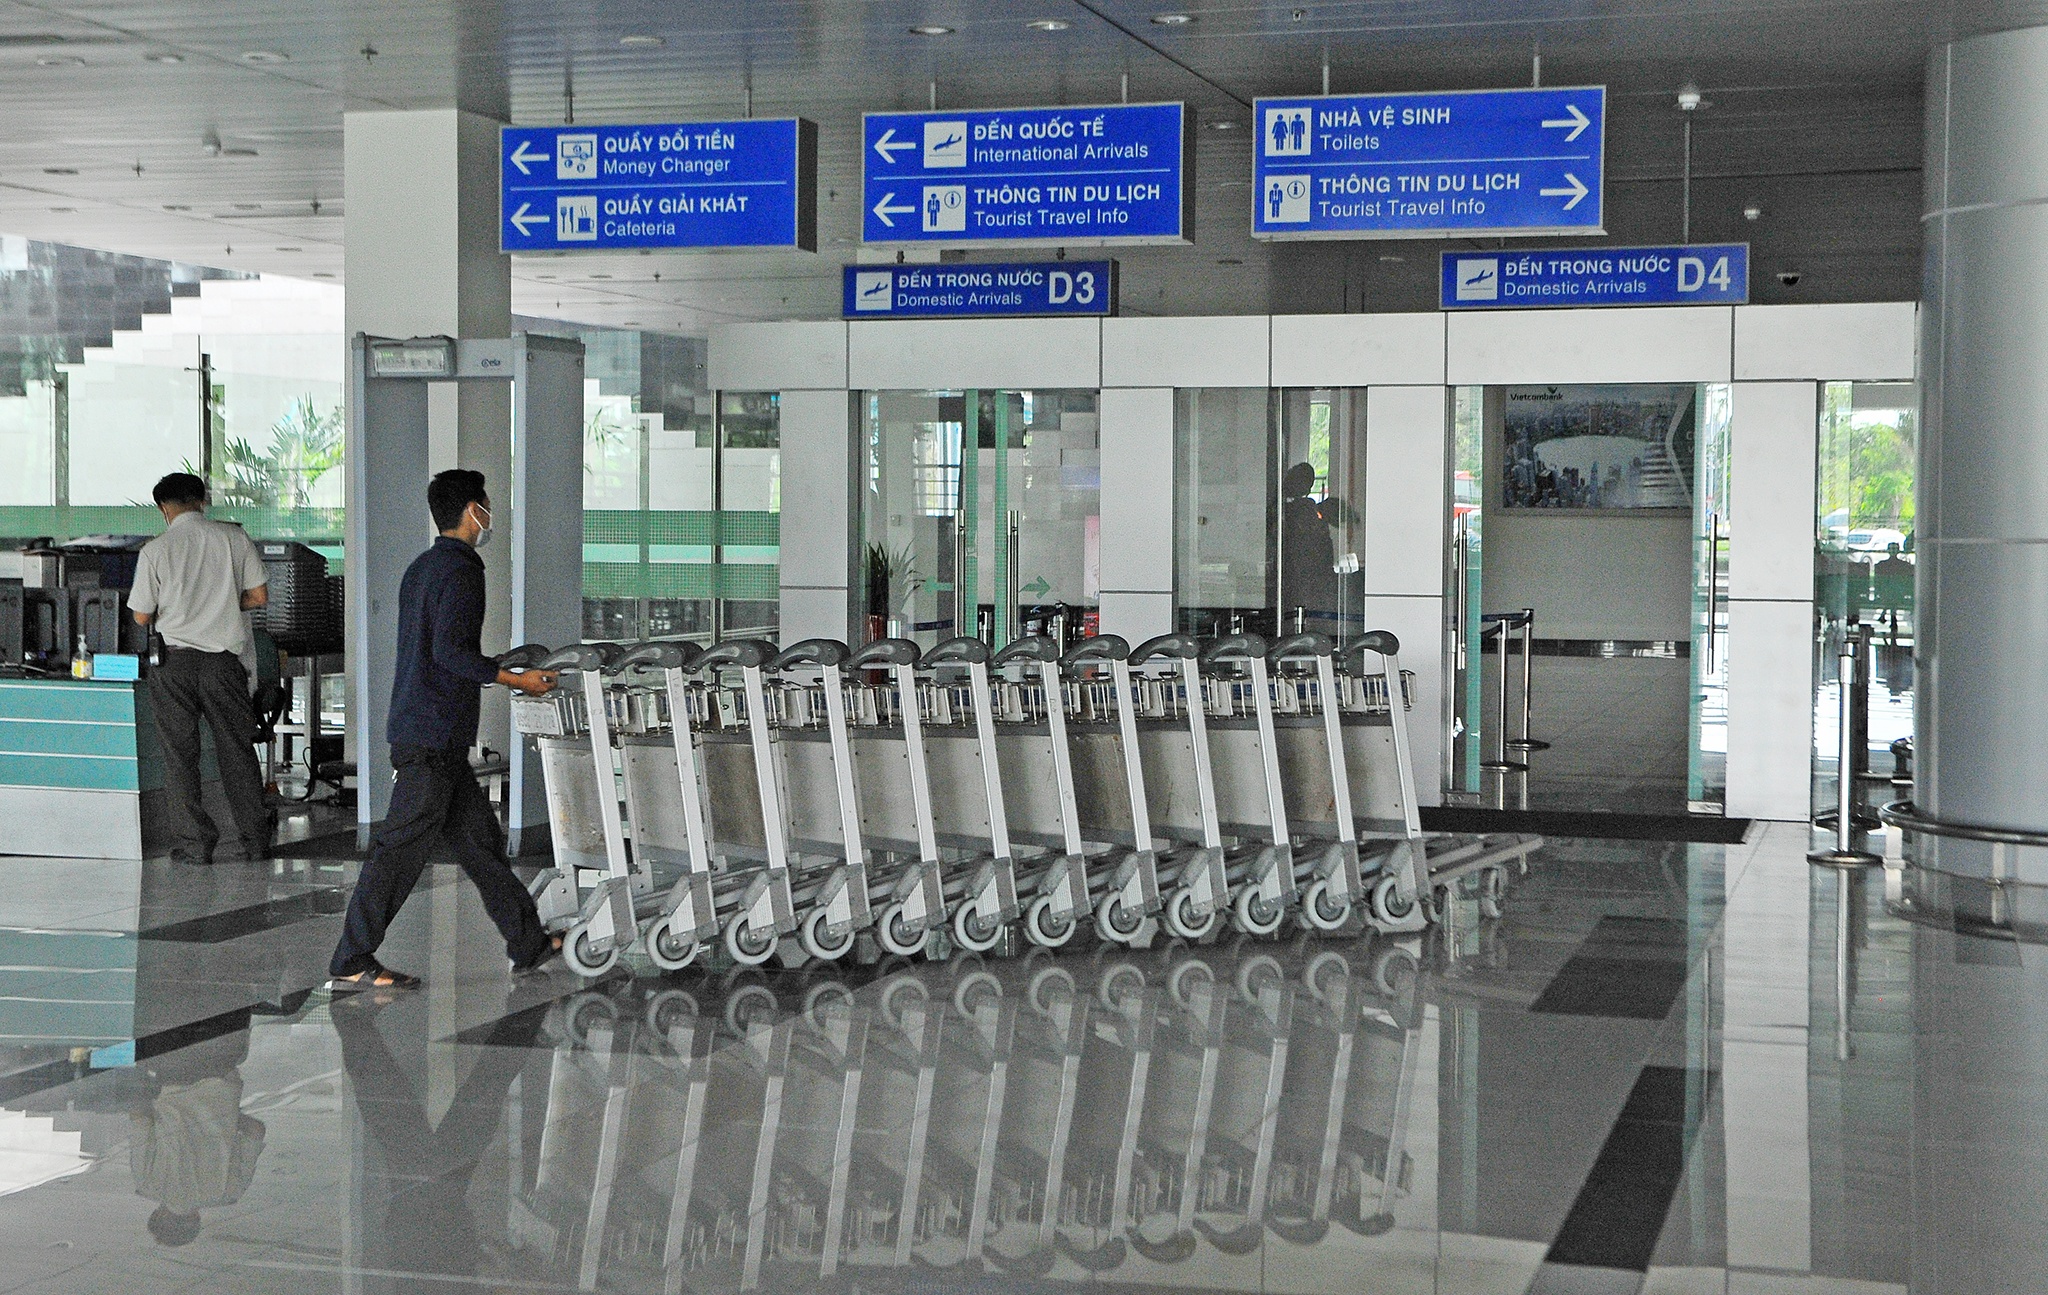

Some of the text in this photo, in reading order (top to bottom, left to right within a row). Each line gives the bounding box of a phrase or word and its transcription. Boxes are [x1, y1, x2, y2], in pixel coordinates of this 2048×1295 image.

[1320, 105, 1450, 128] NHÀ VỆ SINH
[973, 113, 1105, 141] ĐẾN QUỐC TẾ
[659, 129, 689, 151] ĐỔI
[695, 128, 735, 150] TIỀN
[1320, 134, 1379, 150] Toilets
[974, 143, 1148, 162] International Arrivals
[604, 157, 730, 177] Money Changer
[1319, 173, 1520, 194] THÔNG TIN DU LỊCH
[659, 193, 693, 214] GIẢI
[700, 192, 749, 213] KHÁT
[974, 184, 1159, 204] THÔNG TIN DU LỊCH
[974, 208, 1128, 226] Tourist Travel Info
[1319, 198, 1485, 217] Tourist Travel Info
[604, 221, 675, 236] Cafeteria
[1506, 255, 1670, 276] ĐẾN TRONG NƯỚC
[1678, 256, 1731, 291] D4
[898, 269, 1042, 288] ĐẾN TRONG NƯỚC
[1049, 272, 1094, 303] D3
[1505, 279, 1646, 295] Domestic Arrivals
[898, 292, 1021, 306] Domestic Arrivals
[1510, 393, 1563, 401] Vietcombank
